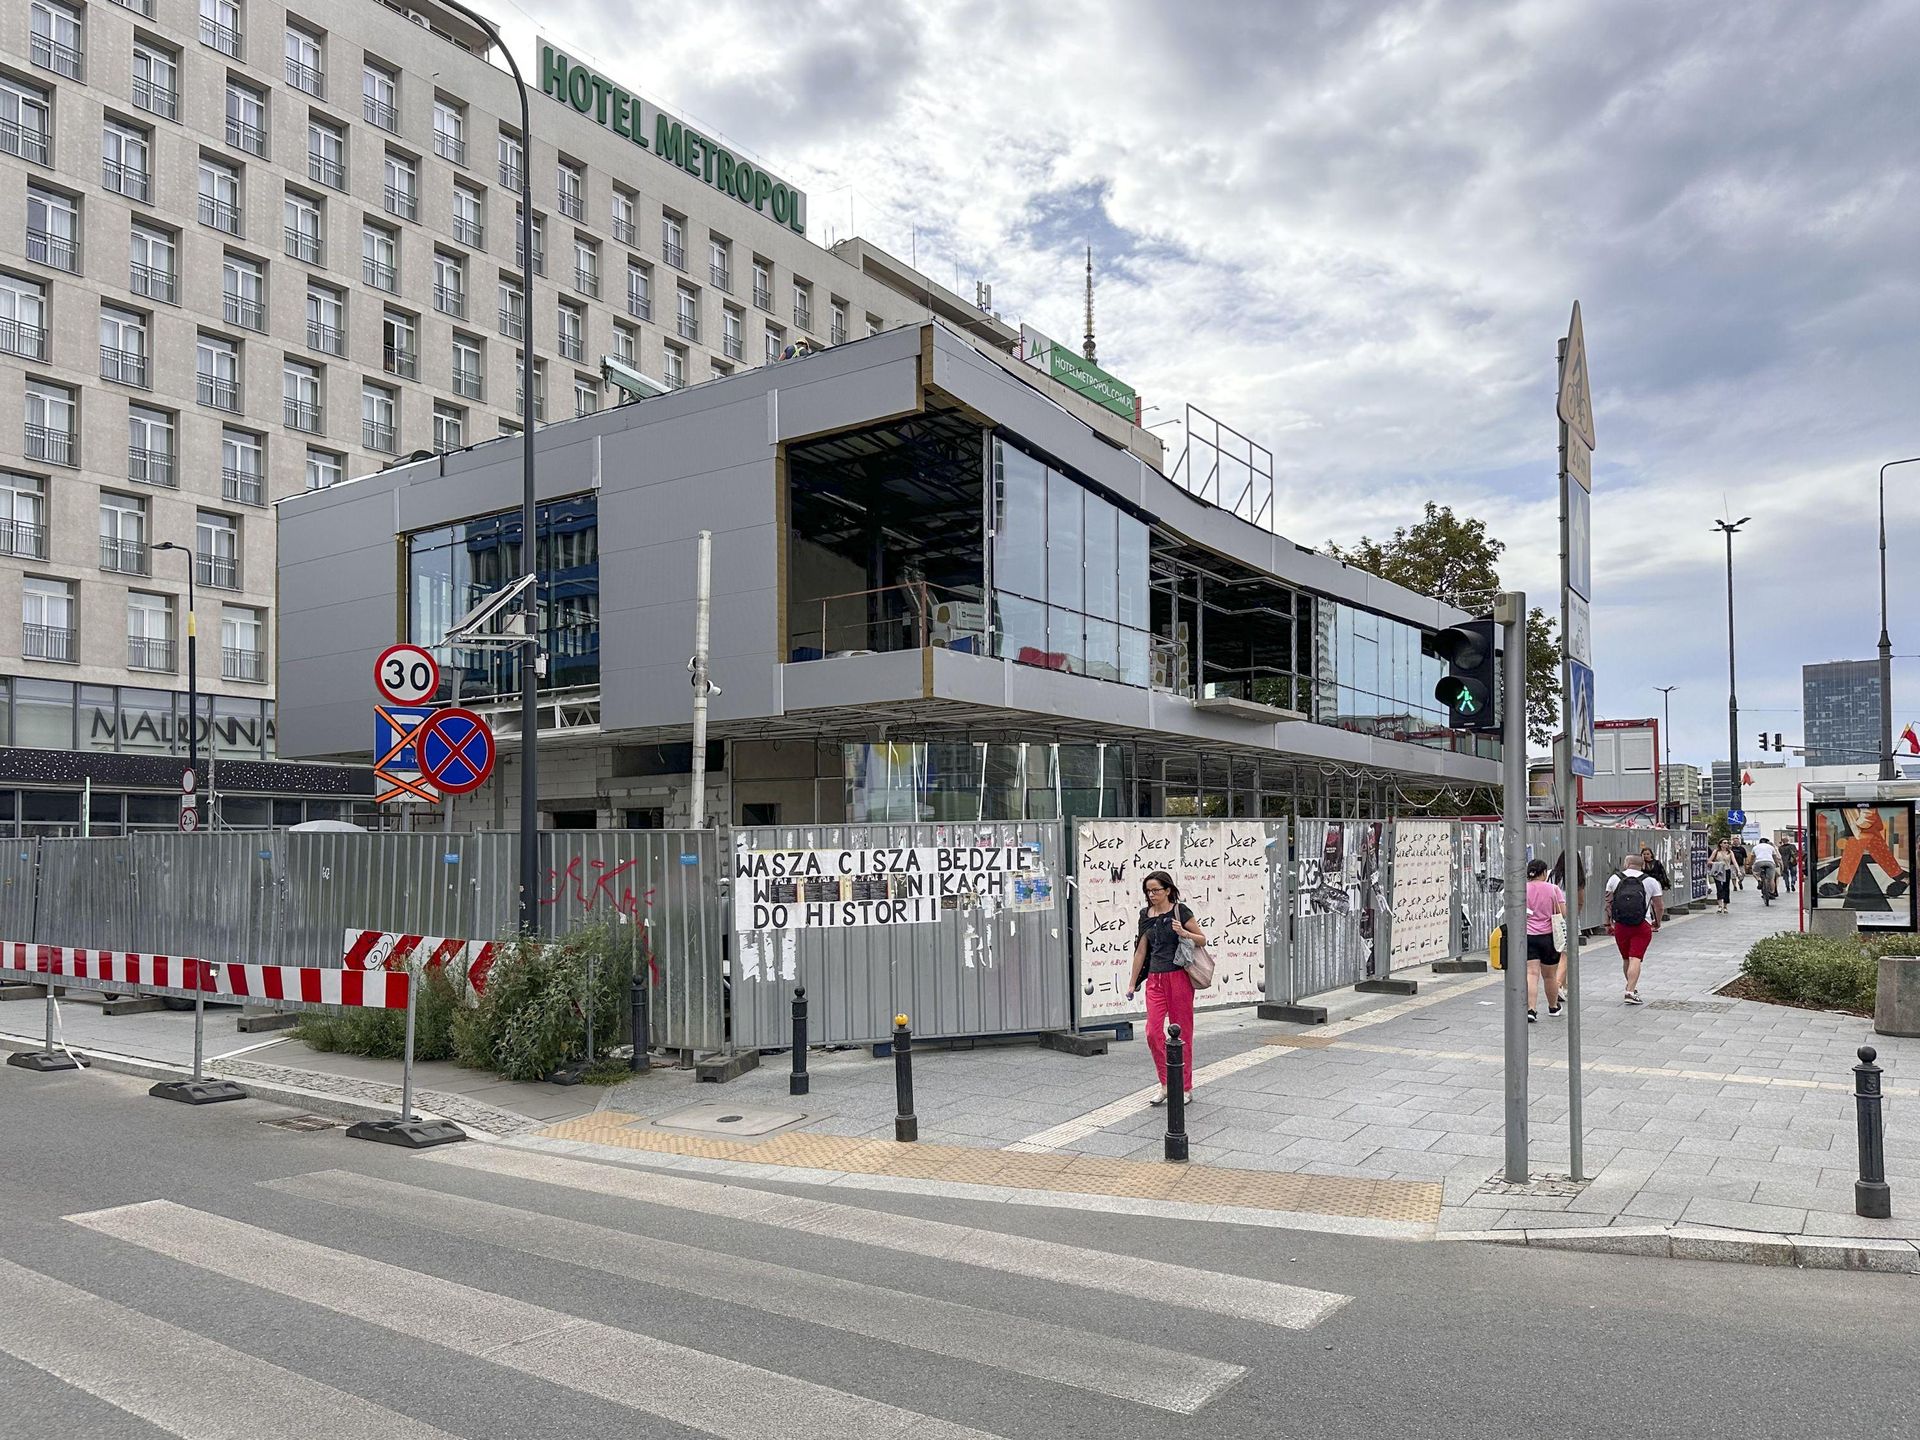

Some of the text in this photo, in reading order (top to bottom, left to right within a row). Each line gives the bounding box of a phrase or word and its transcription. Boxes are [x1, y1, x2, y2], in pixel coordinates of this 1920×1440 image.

[543, 46, 804, 234] HOTEL METROPOL
[1055, 356, 1134, 410] HOTELMETROPOL.COM.PL
[384, 659, 431, 691] 30
[1087, 830, 1124, 852] DEEP
[1138, 830, 1171, 852] DEEP
[1226, 829, 1257, 850] DEEP
[735, 847, 1032, 878] WASZA CISZA BĘDZIE
[753, 879, 770, 903] W
[753, 898, 937, 929] DO HISTORII
[1089, 911, 1126, 934] DEEP
[1197, 916, 1215, 927] EEP
[1225, 906, 1256, 927] DEEP
